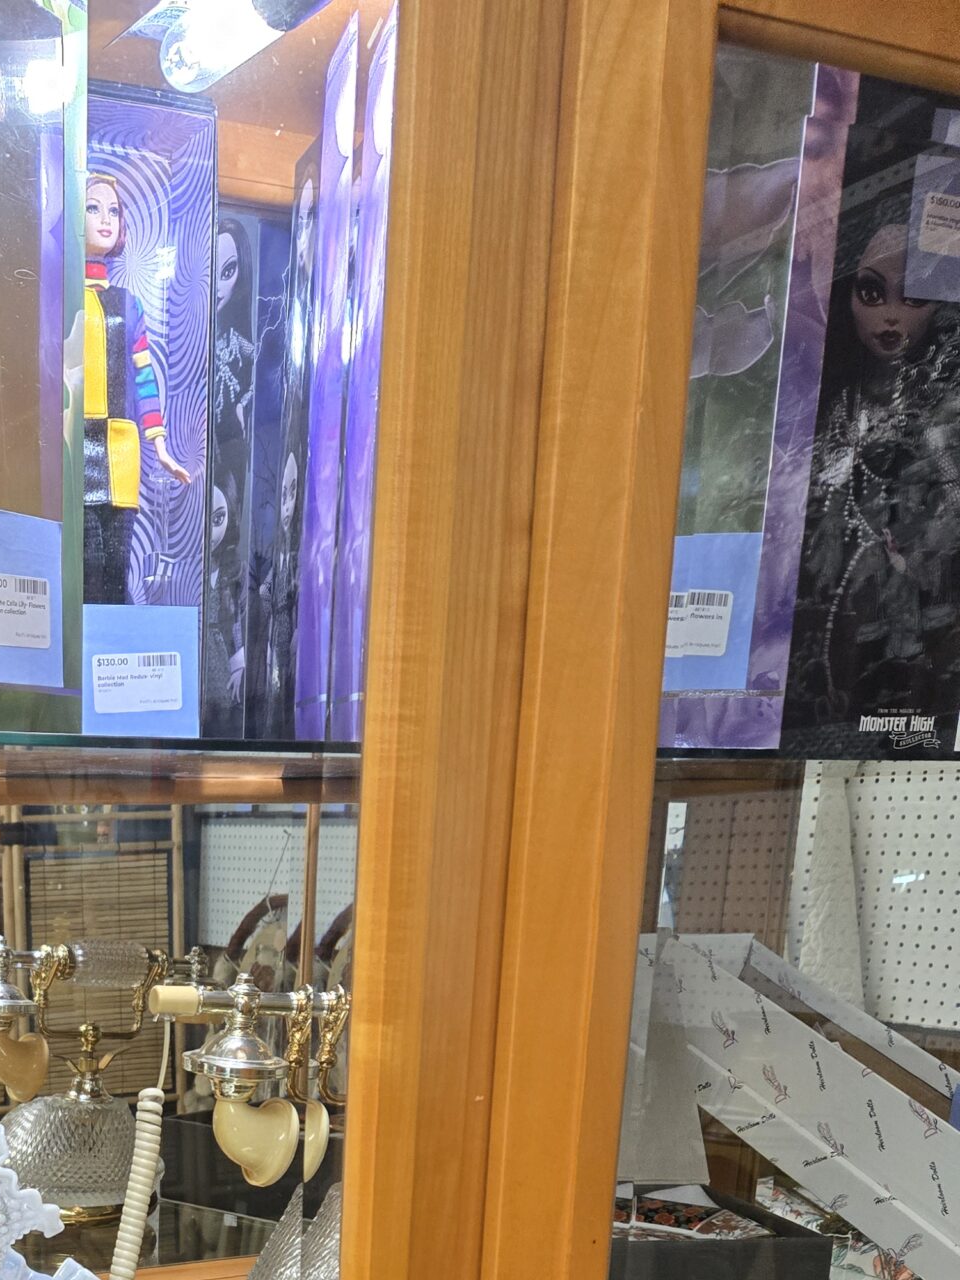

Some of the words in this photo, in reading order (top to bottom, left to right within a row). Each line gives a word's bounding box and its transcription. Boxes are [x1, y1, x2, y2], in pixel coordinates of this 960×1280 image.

[97, 657, 129, 667] $130.00
[859, 715, 907, 732] MONSTER
[909, 715, 935, 732] HIGH
[808, 1041, 818, 1060] Dolls
[815, 1061, 827, 1092] Heirloom
[867, 1099, 877, 1119] Dolls
[874, 1120, 886, 1152] Heirloom
[929, 1161, 940, 1182] Dolls
[937, 1183, 949, 1216] Heirloom
